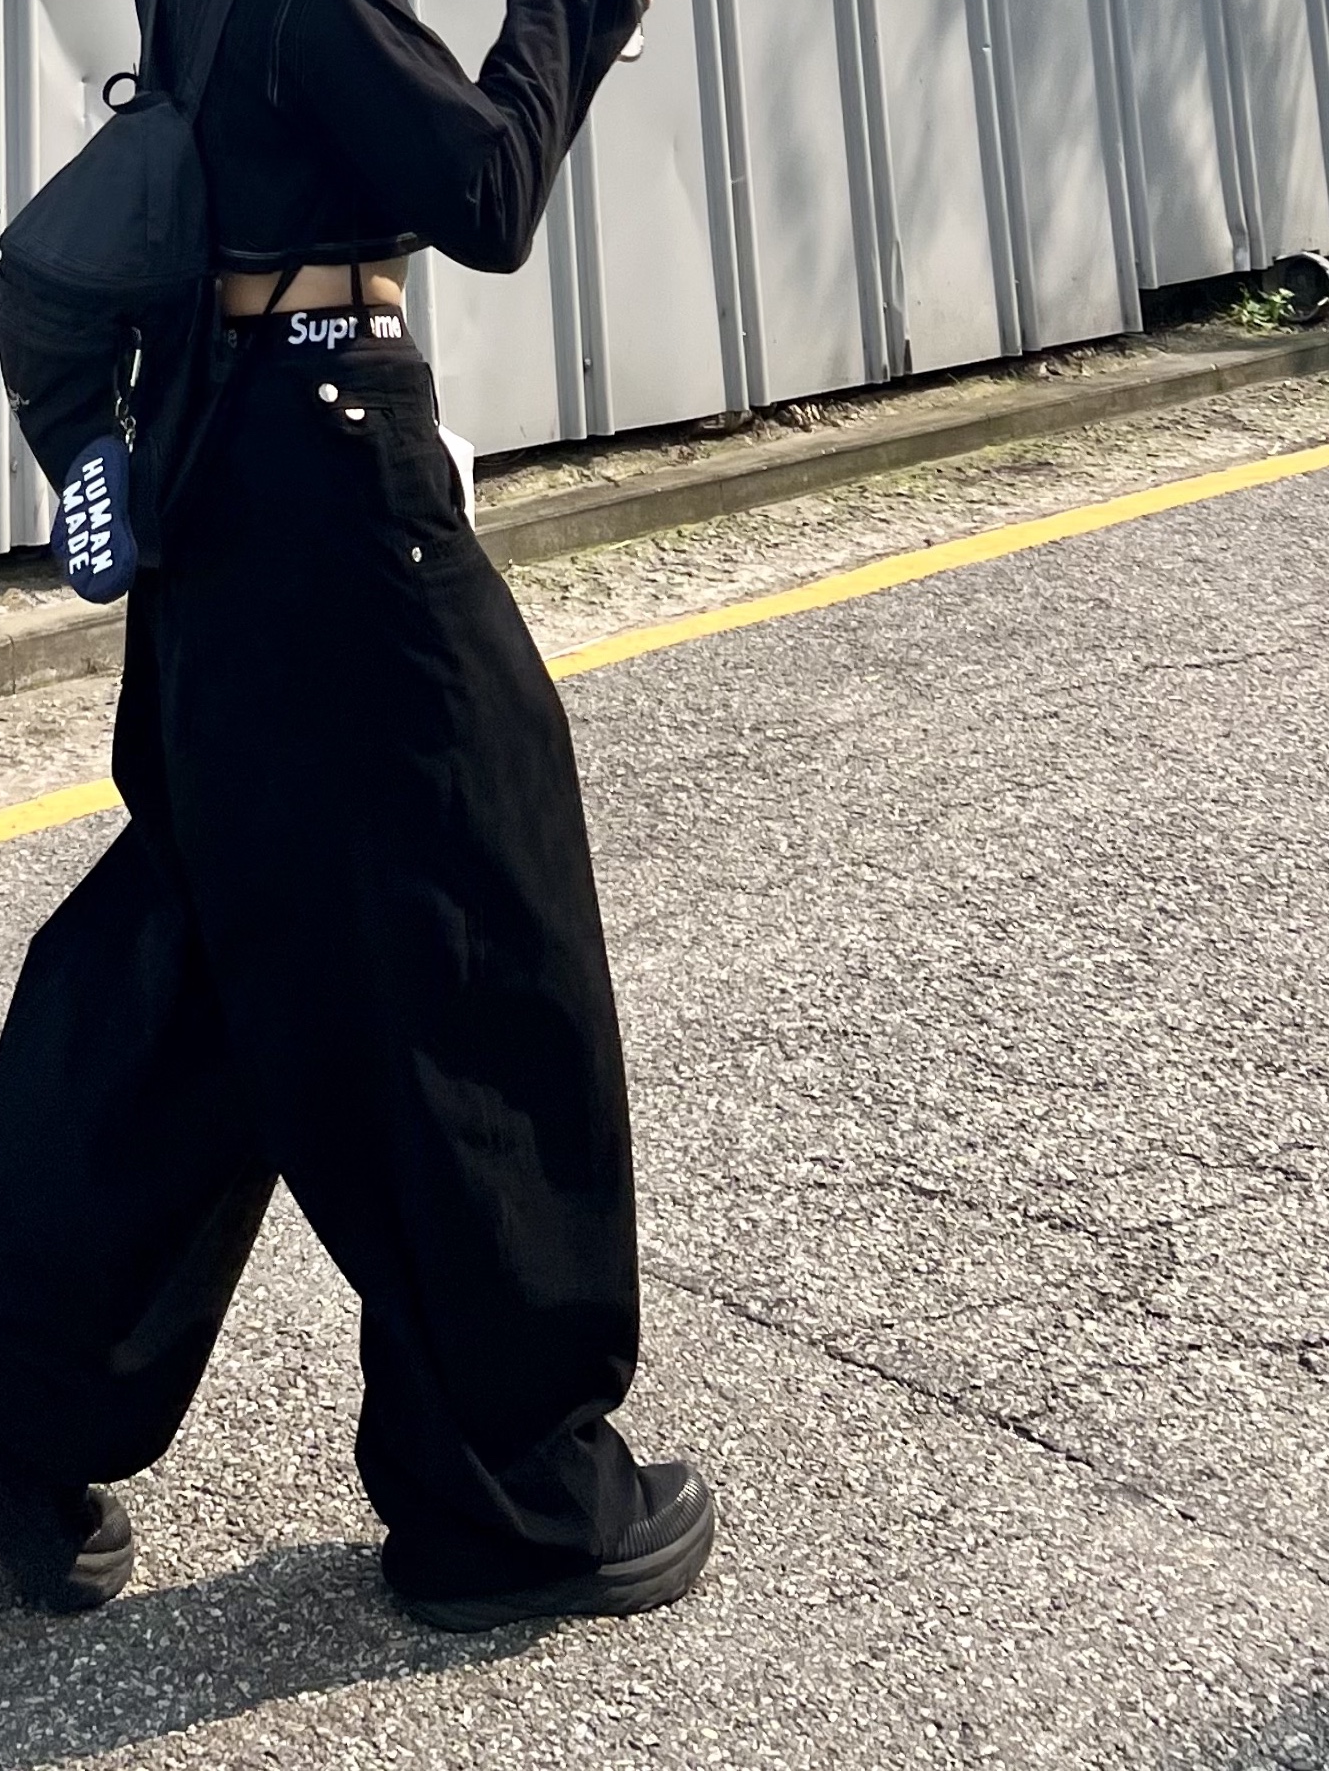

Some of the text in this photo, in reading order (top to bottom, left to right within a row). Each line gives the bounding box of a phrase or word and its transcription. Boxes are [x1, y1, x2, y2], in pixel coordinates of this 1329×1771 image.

[287, 311, 402, 350] Suprme
[62, 479, 90, 575] MADE
[81, 456, 114, 575] HUMAN
